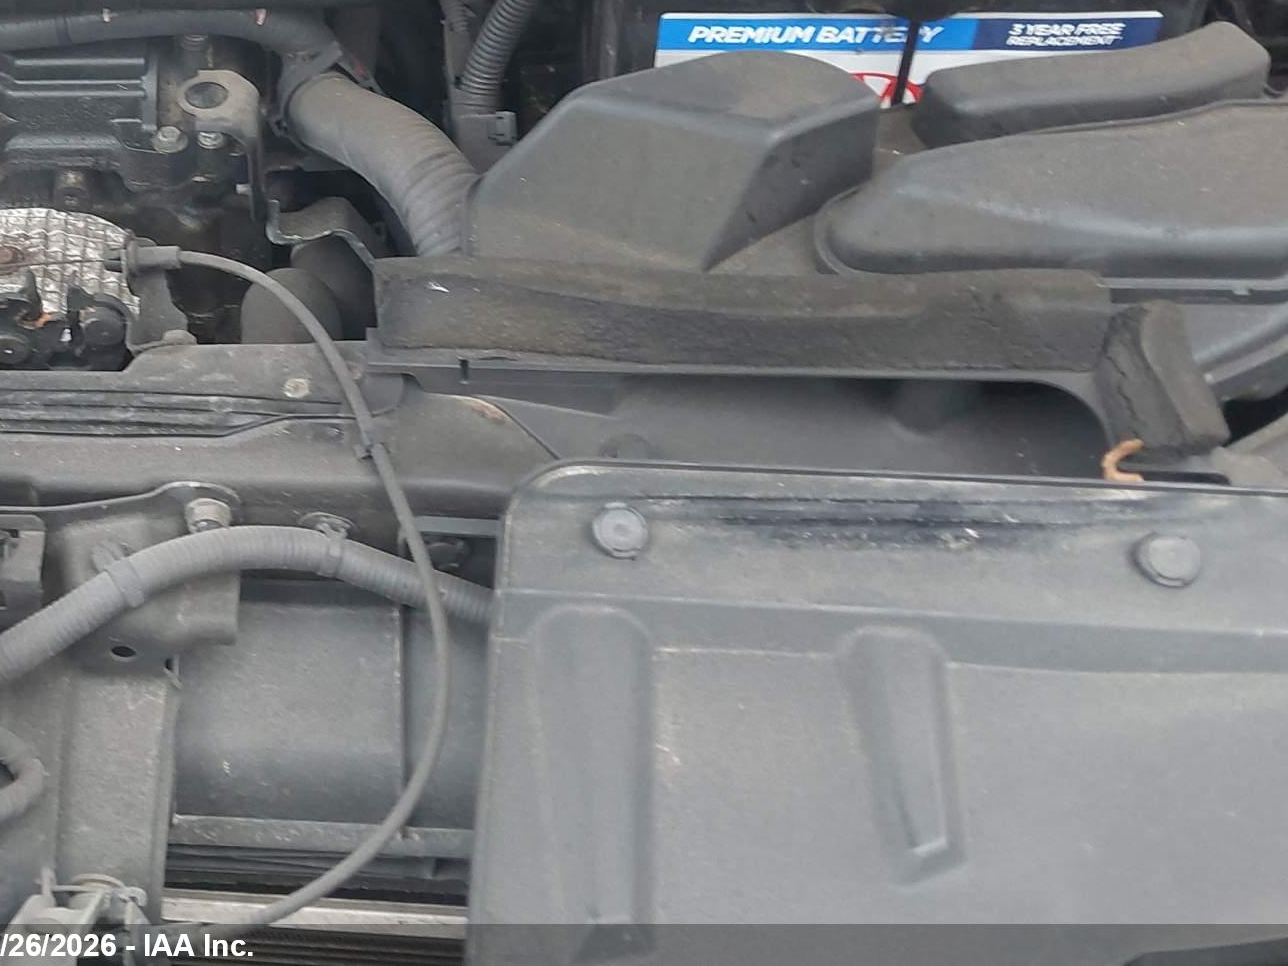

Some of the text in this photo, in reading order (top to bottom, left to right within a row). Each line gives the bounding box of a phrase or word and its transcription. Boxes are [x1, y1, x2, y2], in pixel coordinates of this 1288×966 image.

[688, 26, 815, 44] PREMIUM
[1008, 22, 1126, 36] 3 YEAR FREE
[1006, 35, 1120, 47] REPLACEMENT
